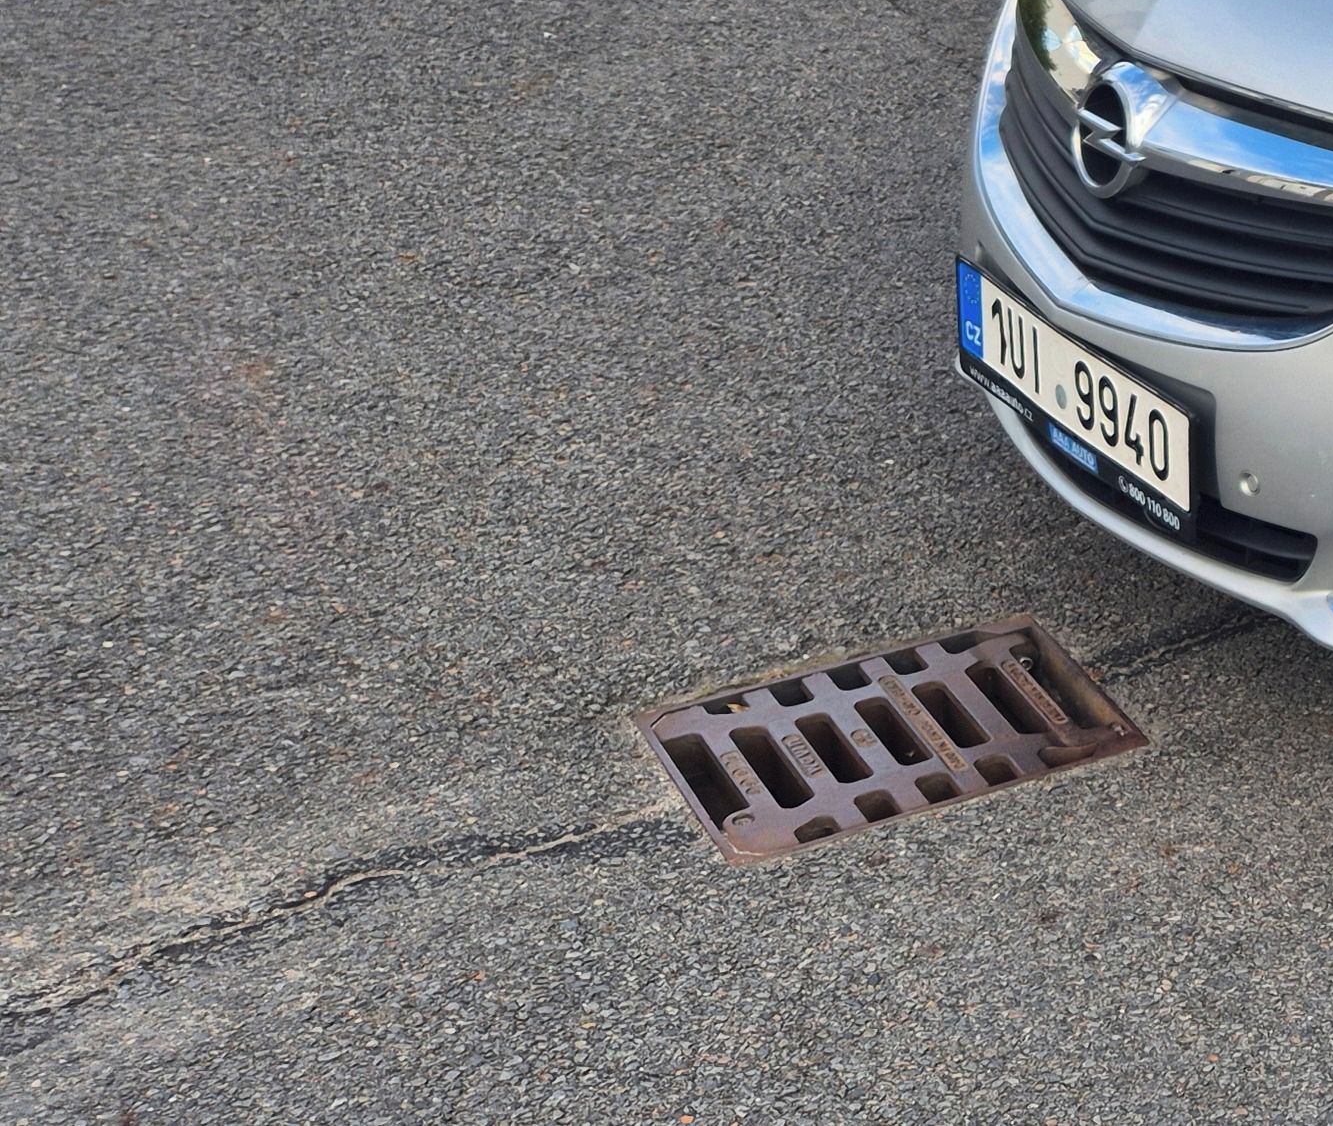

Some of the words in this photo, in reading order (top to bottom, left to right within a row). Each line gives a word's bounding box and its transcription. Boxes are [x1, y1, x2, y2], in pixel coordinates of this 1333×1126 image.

[965, 320, 982, 347] CZ
[991, 298, 1040, 394] 1UI
[1074, 360, 1169, 481] 9940
[1051, 426, 1070, 448] AAA
[1071, 442, 1095, 465] AUTO
[1129, 483, 1146, 505] 800
[1146, 496, 1161, 517] 110
[1163, 508, 1180, 530] 800
